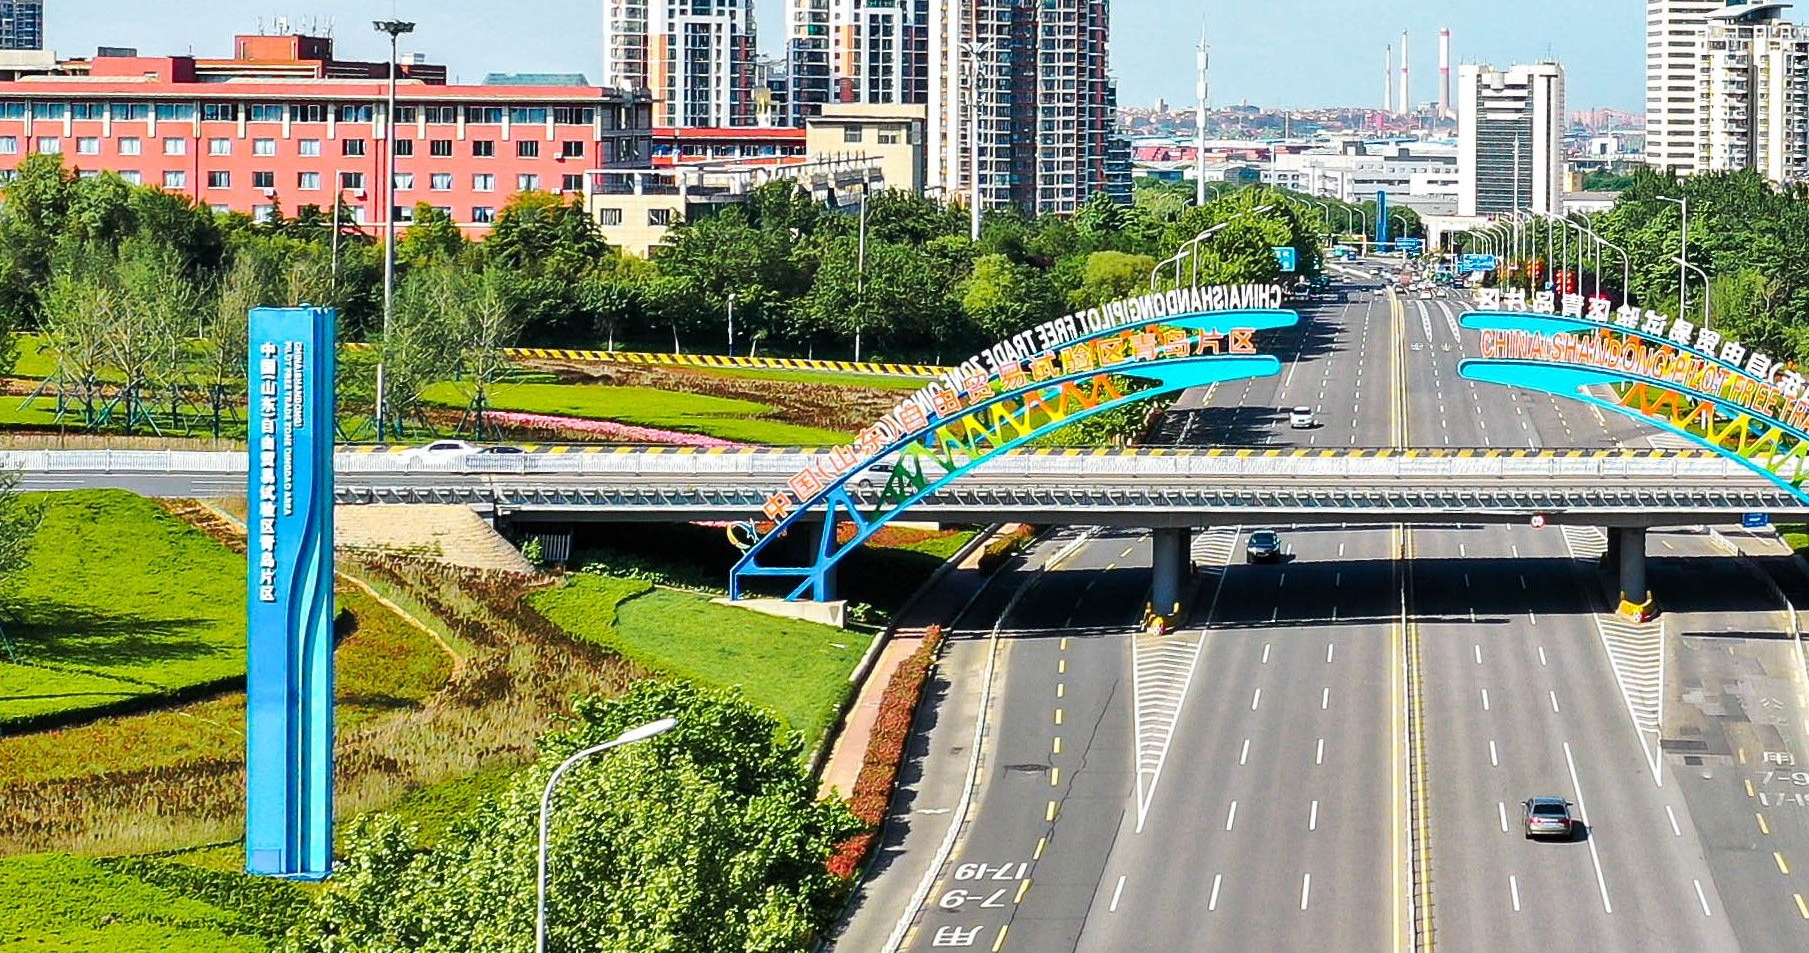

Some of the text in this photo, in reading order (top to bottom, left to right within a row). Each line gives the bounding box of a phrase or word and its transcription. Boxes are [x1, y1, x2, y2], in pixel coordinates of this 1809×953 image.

[1727, 373, 1780, 417] FREE
[954, 862, 1028, 880] 17-19
[939, 889, 1006, 908] 7-9
[932, 925, 984, 946] 用
